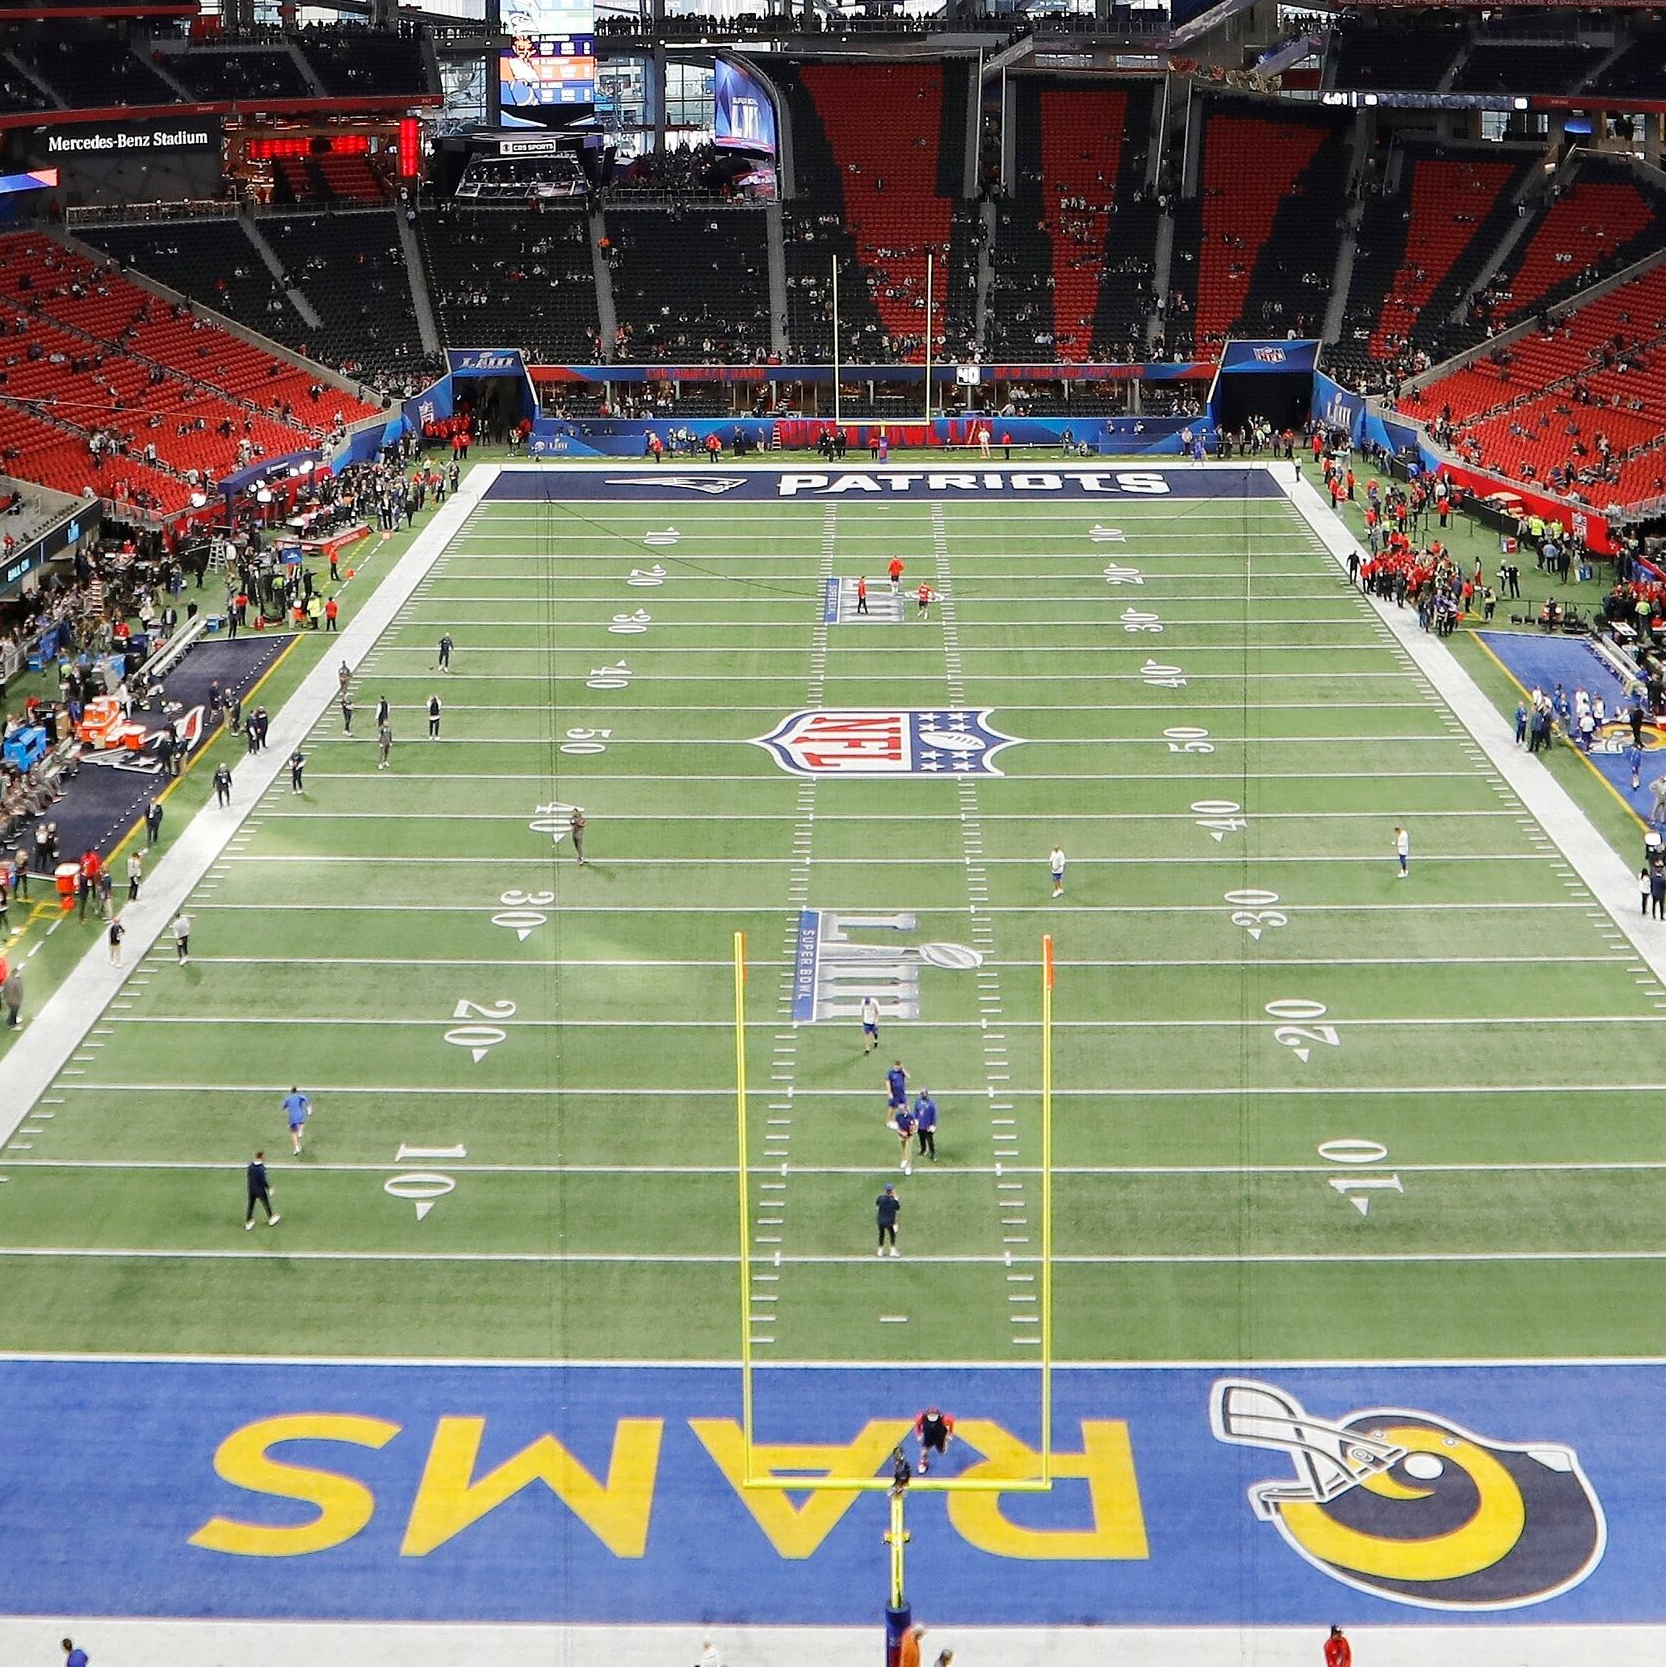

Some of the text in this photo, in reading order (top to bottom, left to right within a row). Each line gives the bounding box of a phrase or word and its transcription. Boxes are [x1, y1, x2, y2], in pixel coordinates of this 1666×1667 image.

[48, 130, 208, 152] Mercedes-Benz Stadium
[513, 142, 554, 152] CBS SPORTS
[958, 367, 980, 384] 40
[778, 472, 1171, 496] PATRIOTS
[643, 530, 681, 545] 10
[1088, 528, 1127, 543] 10
[627, 568, 667, 587] 20
[1103, 567, 1145, 585] 20
[607, 613, 652, 634] 30
[1119, 613, 1164, 633] 30
[585, 665, 633, 686] 40
[1139, 664, 1188, 688] 40
[559, 727, 612, 754] 50
[789, 717, 902, 768] NFL
[1162, 726, 1215, 754] 50
[528, 801, 585, 833] 40
[1189, 800, 1248, 832] 40
[490, 889, 555, 929] 30
[1223, 888, 1289, 928] 30
[797, 929, 815, 1001] SUPER BOWL
[443, 999, 517, 1047] 20
[1264, 998, 1341, 1047] 20
[383, 1142, 468, 1199] 10
[1317, 1138, 1405, 1195] 10
[186, 1413, 1150, 1561] RAMS
